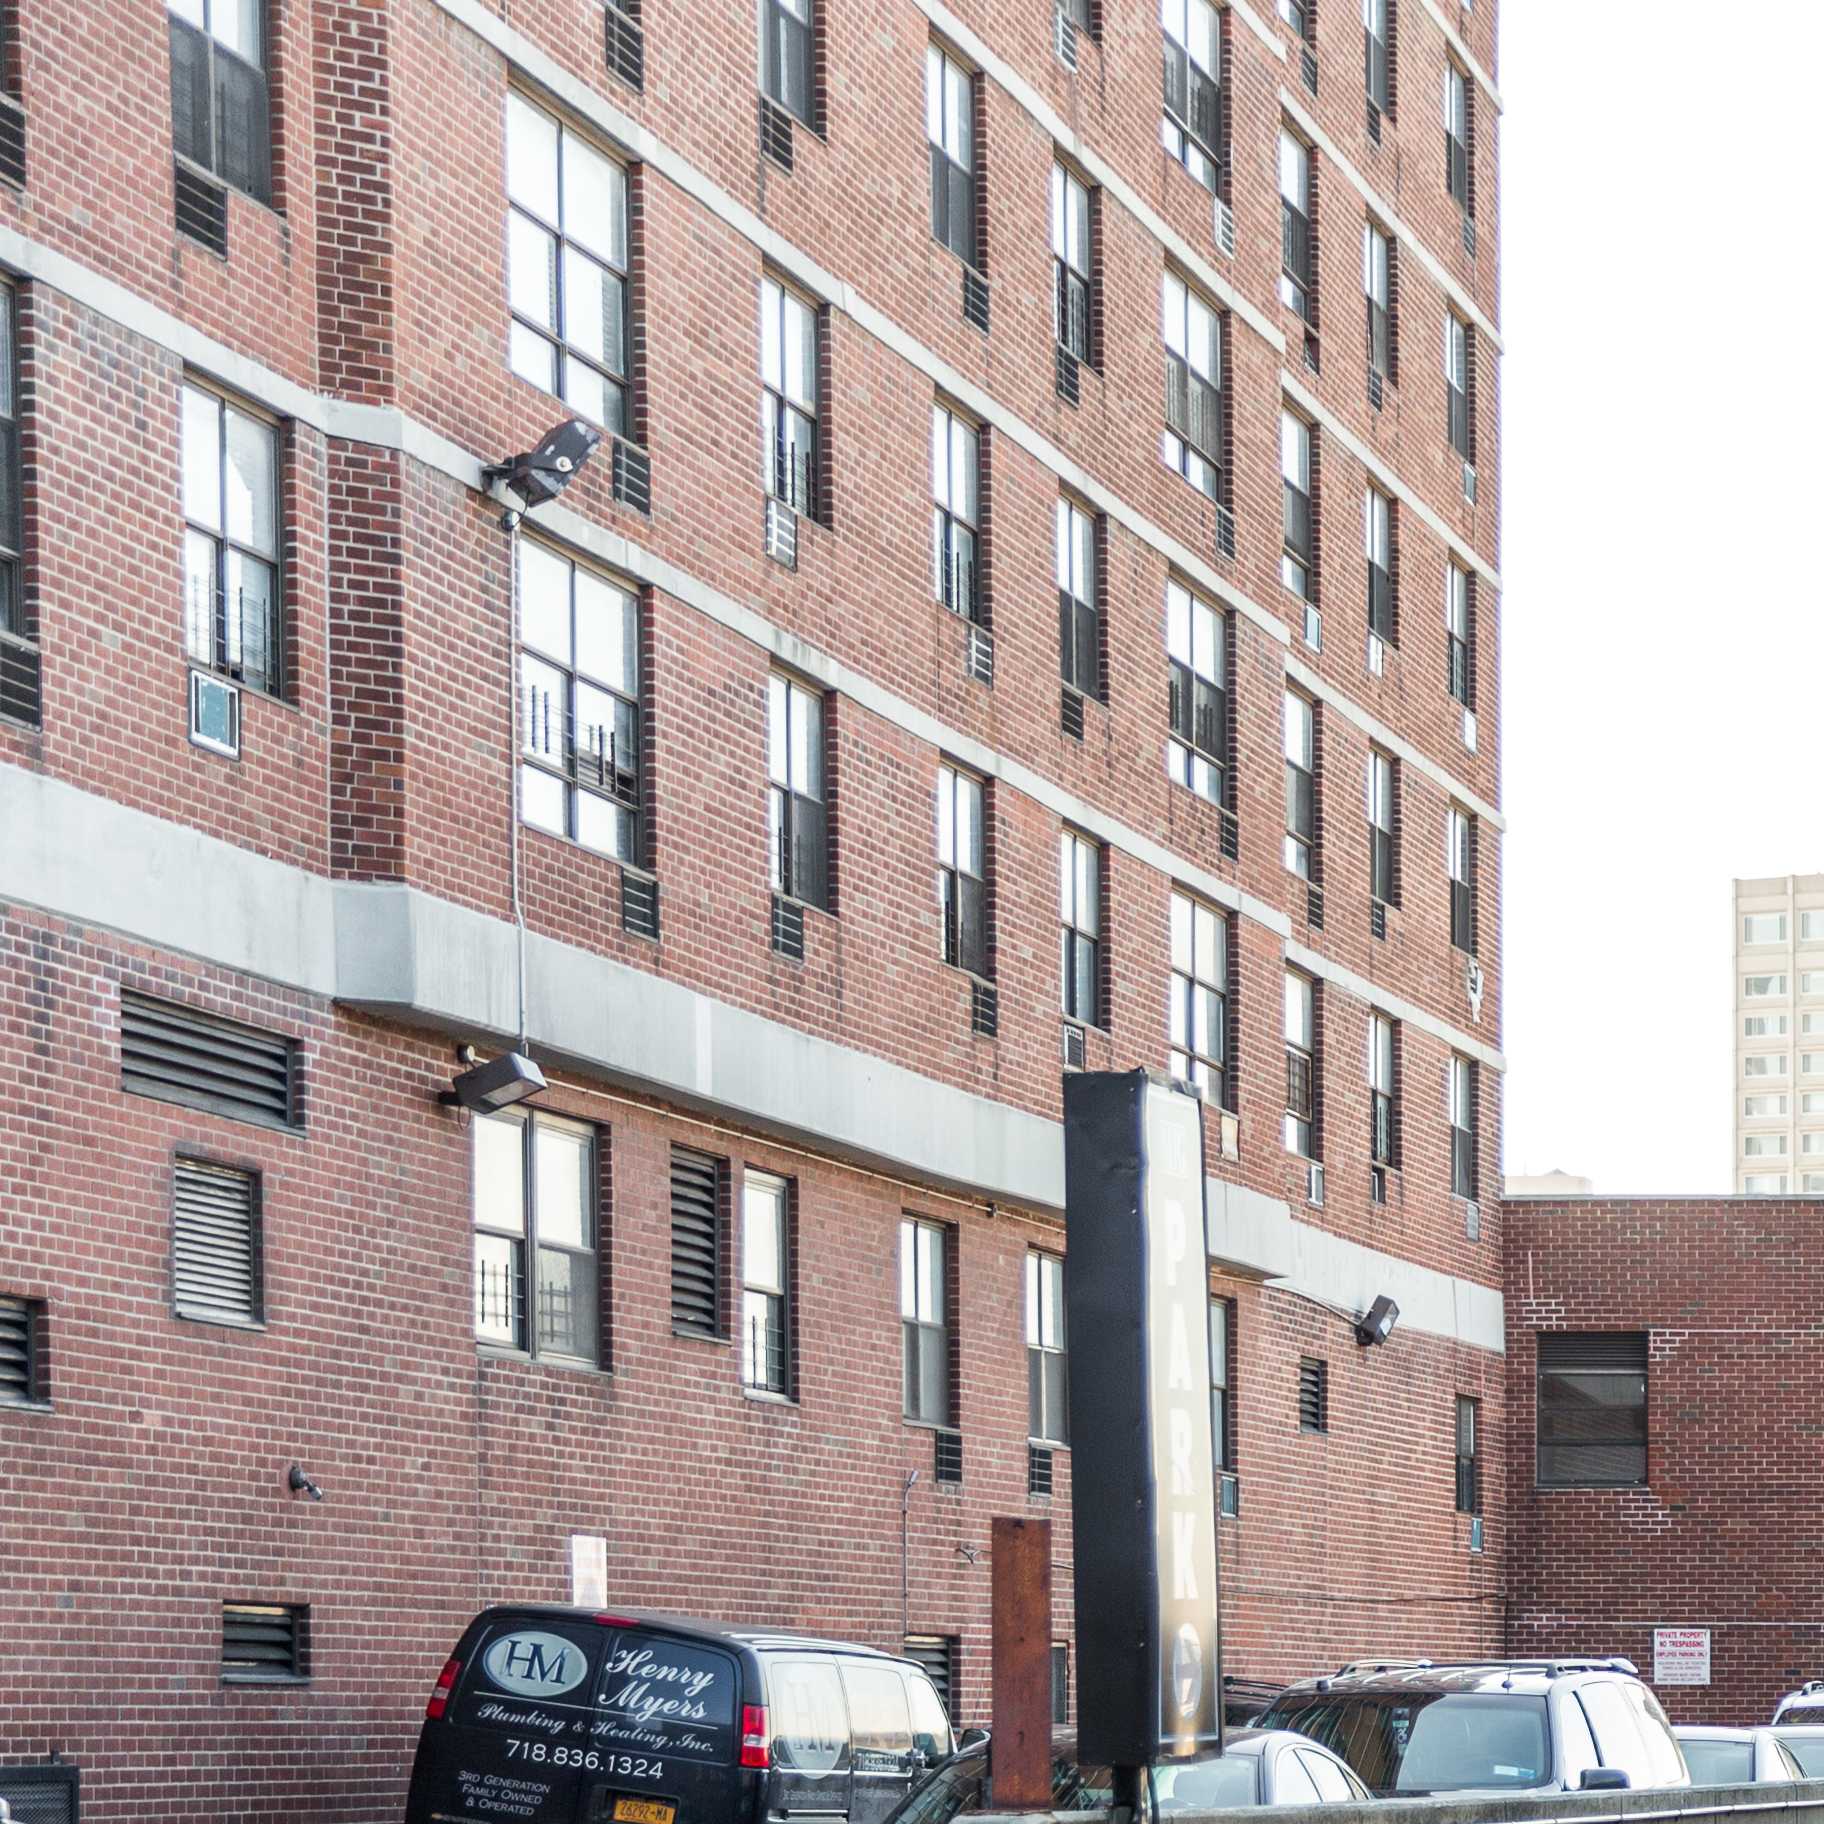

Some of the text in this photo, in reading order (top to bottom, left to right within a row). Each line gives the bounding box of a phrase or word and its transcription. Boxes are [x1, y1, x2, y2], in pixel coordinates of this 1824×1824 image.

[505, 1639, 567, 1685] HM
[605, 1649, 714, 1697] Henry
[599, 1680, 707, 1720] Myers
[477, 1703, 567, 1735] Plumbing
[572, 1720, 585, 1733] &
[675, 1733, 714, 1752] Inc.
[506, 1739, 664, 1780] 718.836.1324
